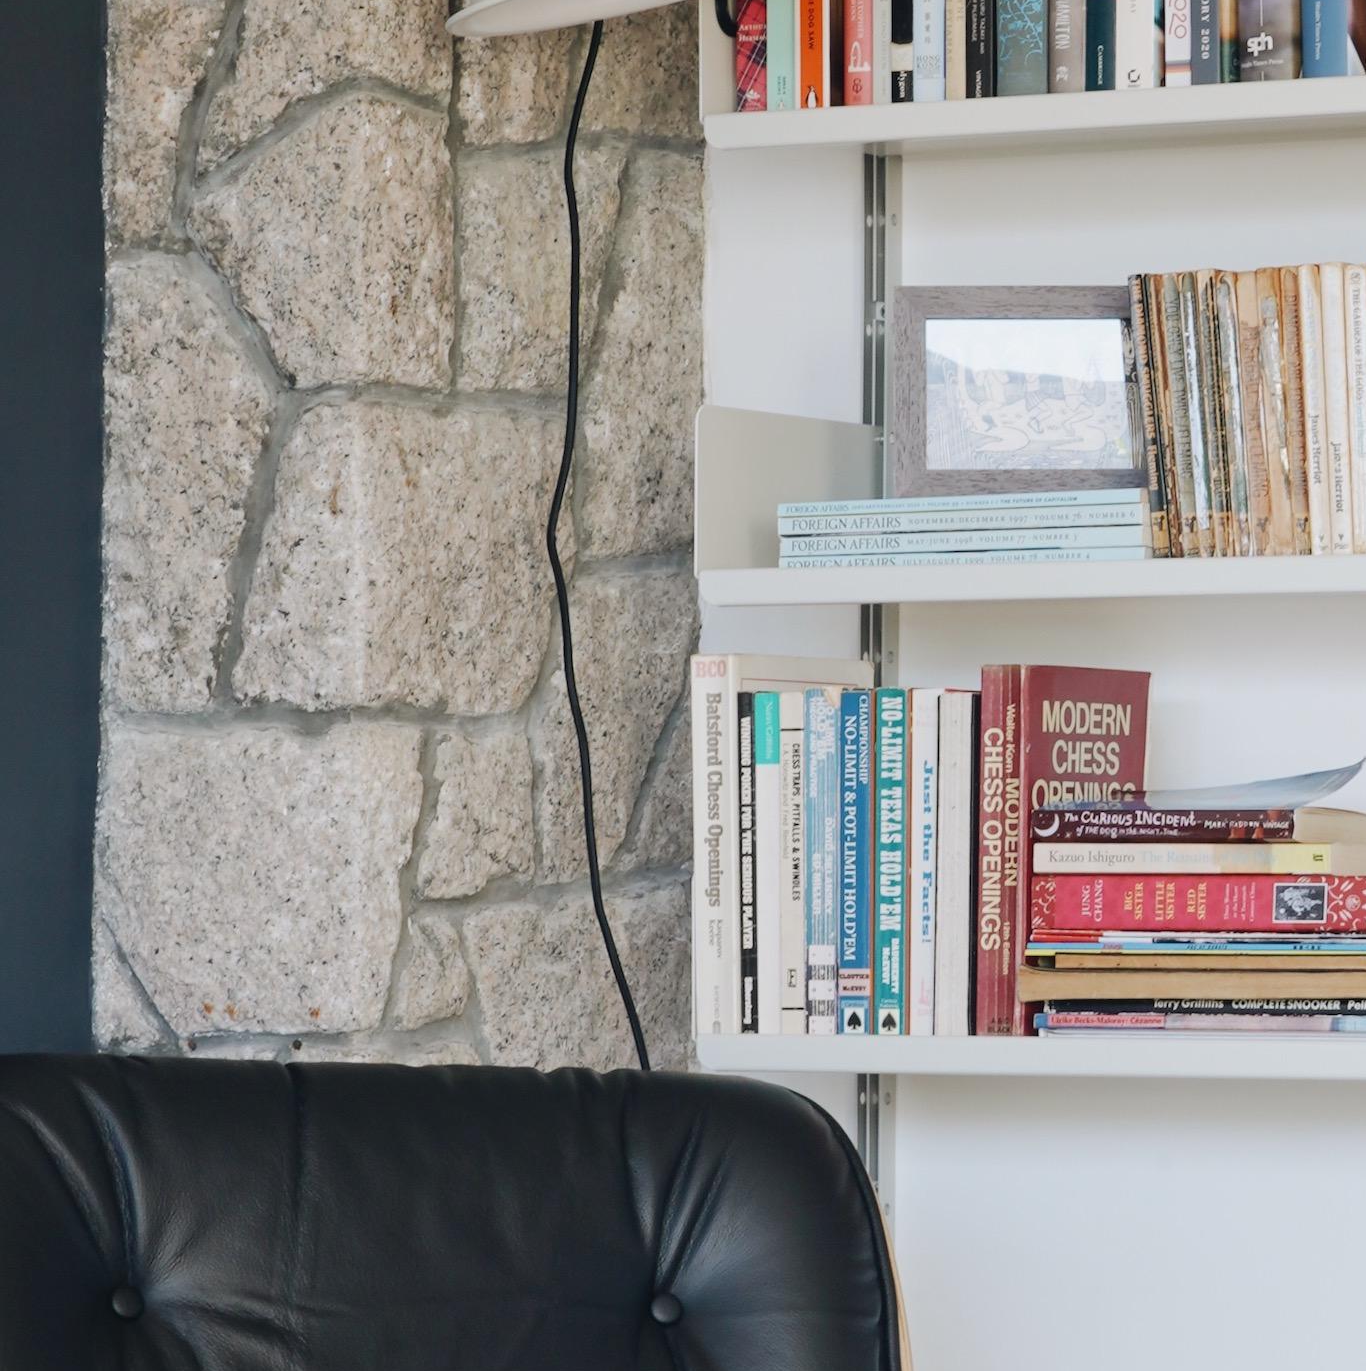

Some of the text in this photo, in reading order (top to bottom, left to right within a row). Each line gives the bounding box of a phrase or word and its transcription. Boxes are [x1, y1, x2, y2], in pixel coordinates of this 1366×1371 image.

[792, 516, 900, 530] FOREIGN AFFAIRS
[791, 537, 900, 552] FOREIGN AFFAIRS
[1042, 700, 1131, 736] MODERN
[792, 744, 800, 769] CHESS
[1052, 740, 1119, 776] CHESS
[705, 693, 724, 907] Batsford Chess Openings
[792, 772, 800, 801] TRAPS,
[792, 804, 800, 844] PITFALLS
[880, 697, 902, 930] NO-LIMIT TEXAS HOLD'EM
[921, 760, 933, 943] Just the Facts!
[981, 728, 1003, 950] CHESS OPENINGS
[1050, 851, 1134, 864] Kazuo Ishiguro
[792, 857, 800, 901] SWINDLES
